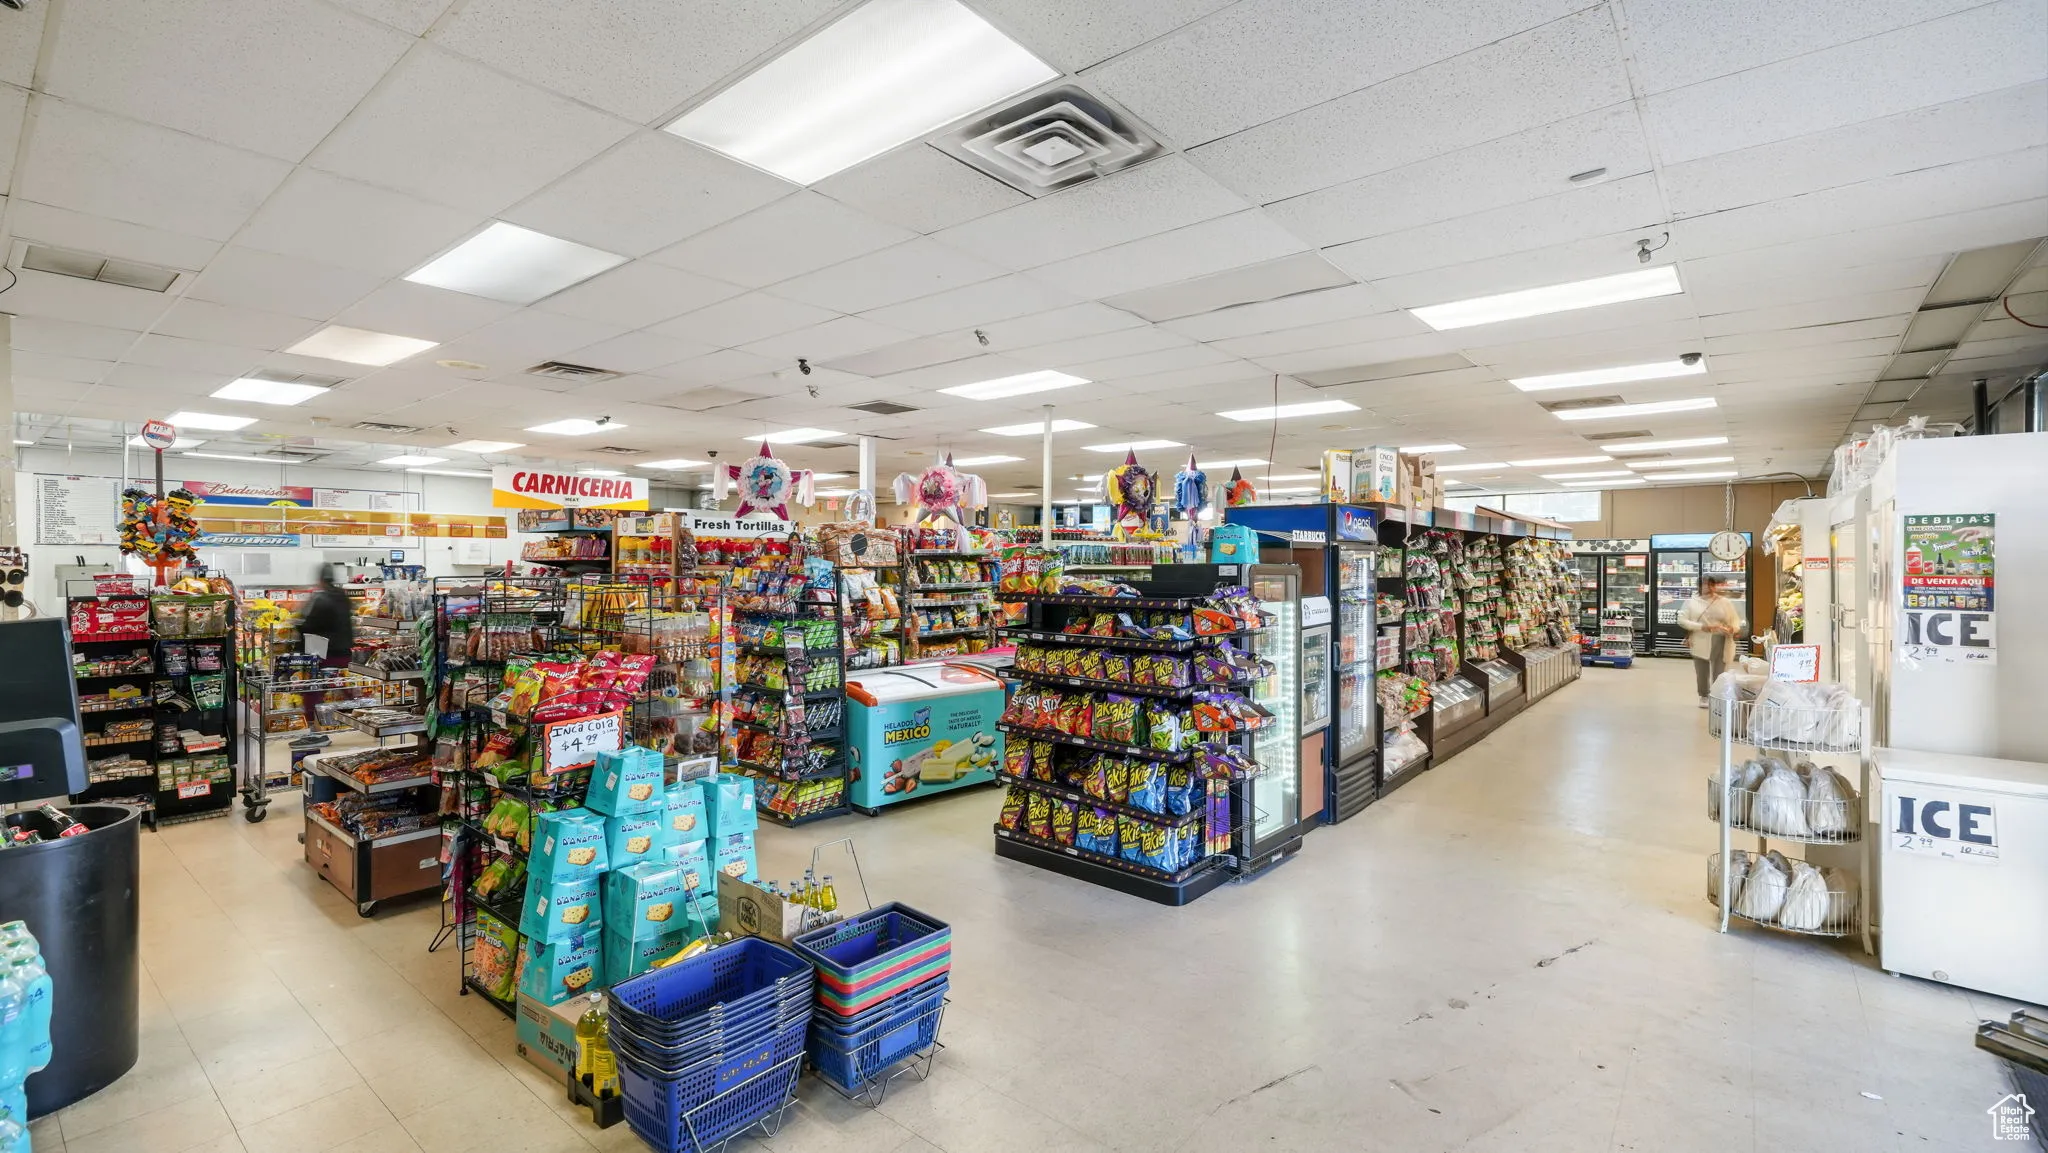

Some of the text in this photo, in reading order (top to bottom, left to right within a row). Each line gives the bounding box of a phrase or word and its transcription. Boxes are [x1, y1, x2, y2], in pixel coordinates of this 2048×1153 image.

[204, 481, 291, 497] Budweiser
[512, 471, 633, 499] CARNICERIA
[694, 518, 785, 532] Fresh Tortillas
[1353, 516, 1371, 530] pepsi
[1908, 515, 1991, 525] BEBIDAS
[1292, 529, 1326, 543] STARBUCKS
[1960, 577, 1986, 586] AQUÍ
[1904, 612, 1990, 648] ICE
[1063, 648, 1081, 664] Taki
[1026, 695, 1040, 711] STI
[1041, 696, 1062, 713] STIX
[119, 721, 143, 731] Susy
[884, 719, 914, 730] HELADOS
[884, 724, 931, 746] MEXICO
[1896, 796, 1993, 845] ICE
[1140, 829, 1167, 853] Takis
[806, 917, 829, 930] KOLA
